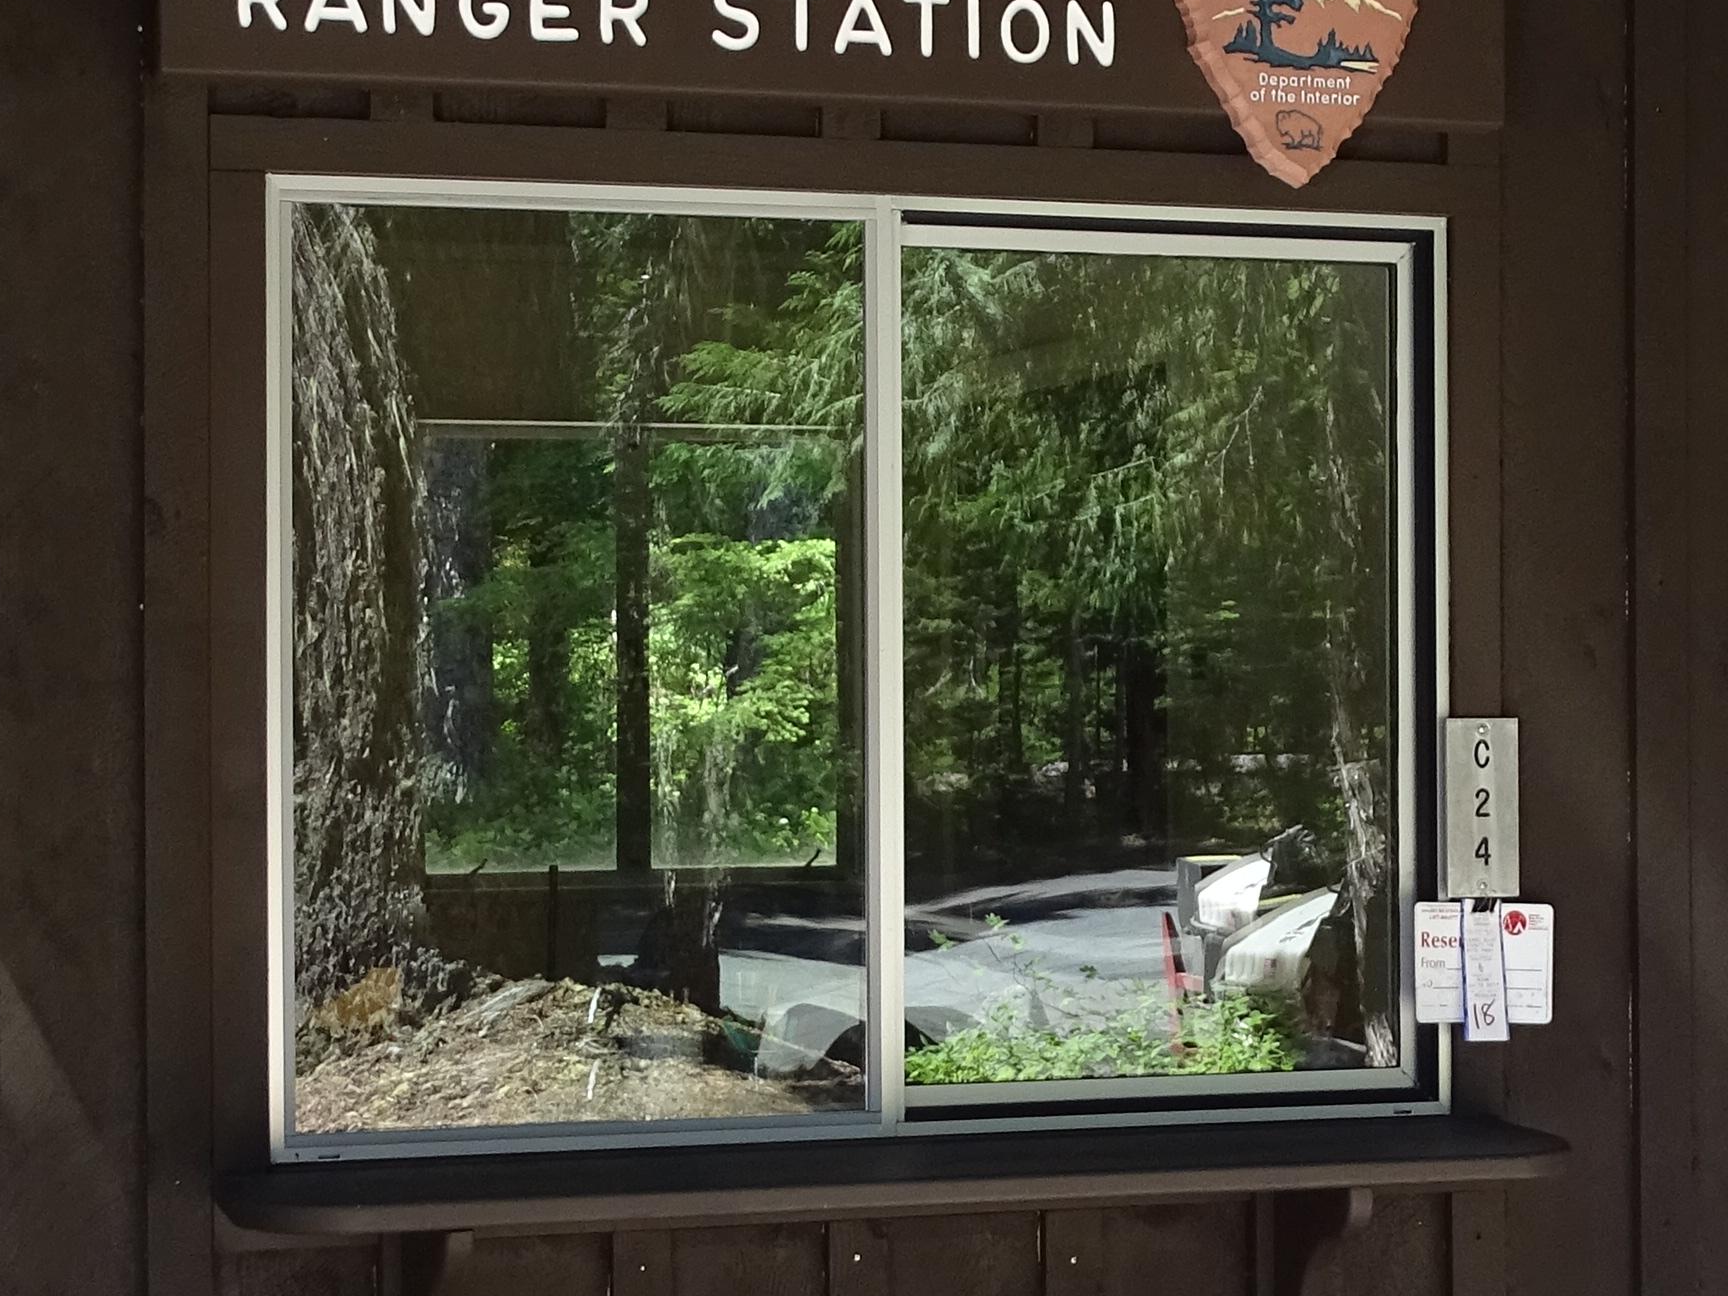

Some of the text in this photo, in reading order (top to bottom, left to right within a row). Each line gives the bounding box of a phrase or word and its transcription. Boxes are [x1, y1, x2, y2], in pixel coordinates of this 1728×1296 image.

[1258, 71, 1352, 90] Department
[1249, 87, 1361, 106] of the Interior
[1420, 931, 1462, 950] Rese
[1420, 957, 1446, 969] From
[1472, 998, 1496, 1030] 18
